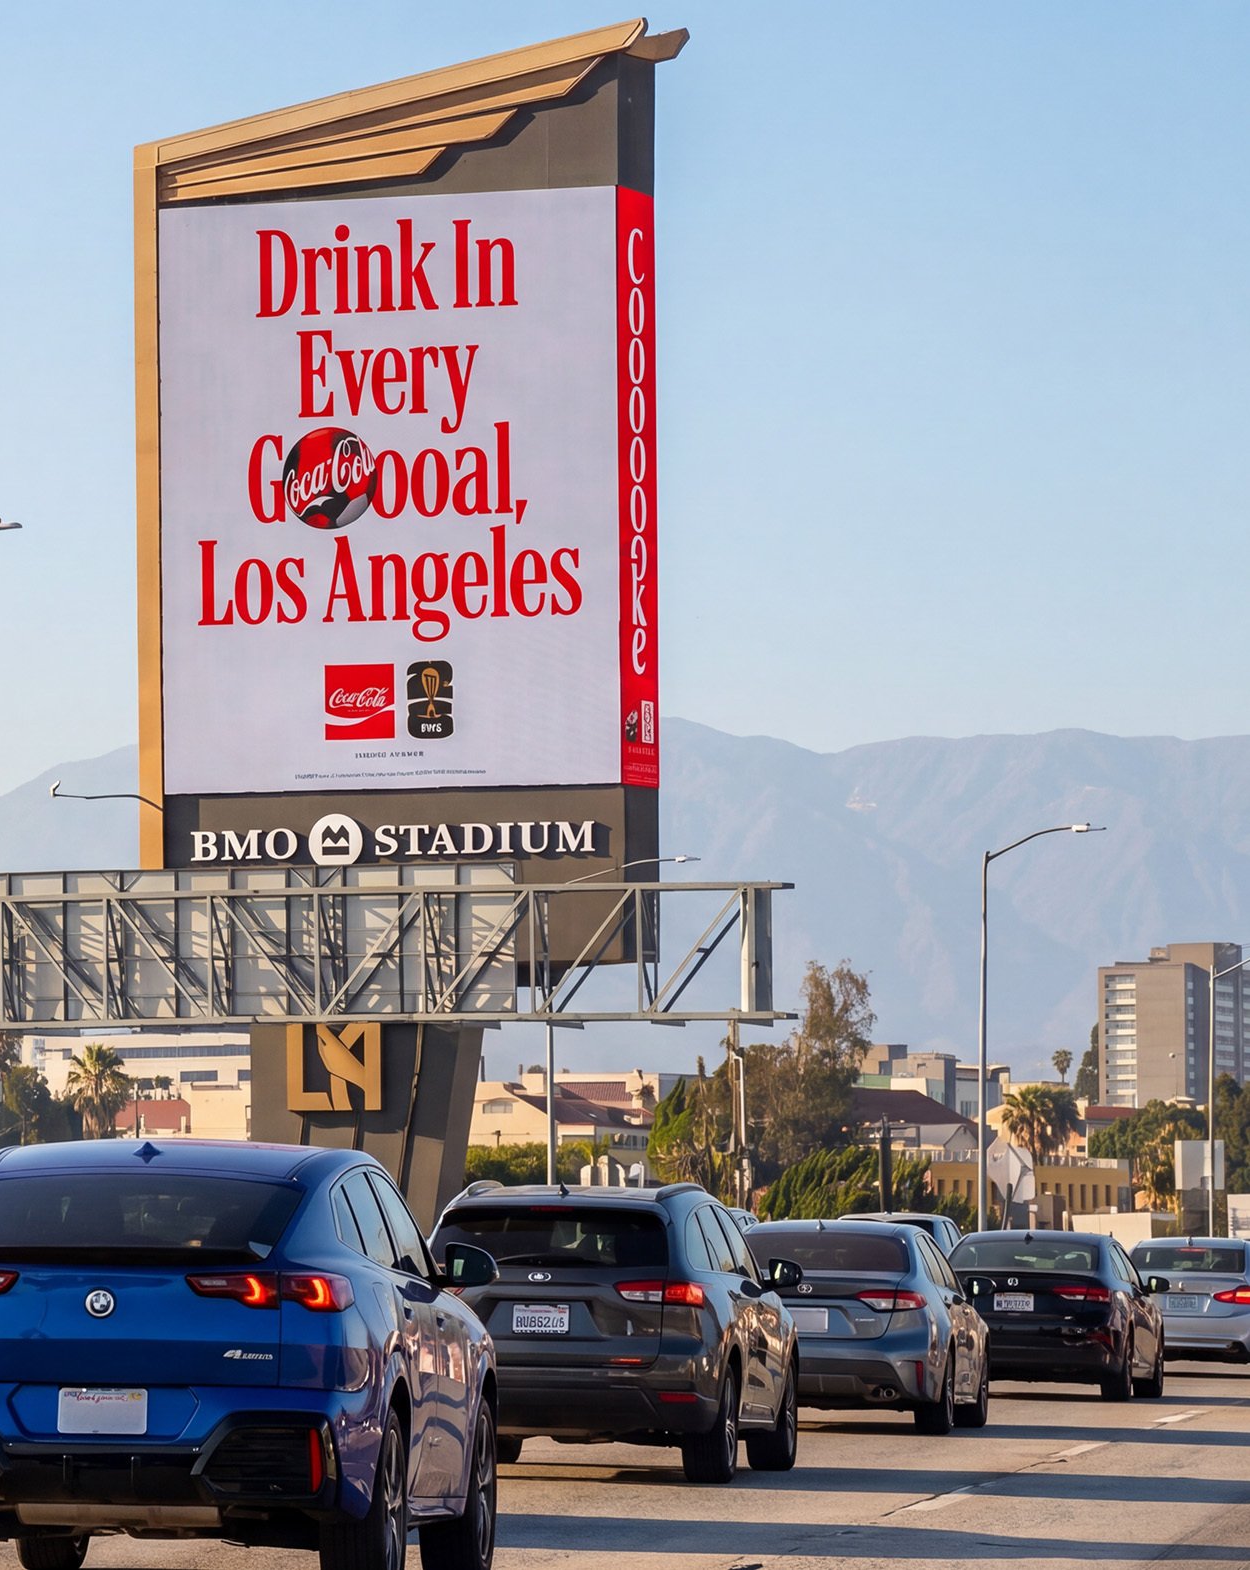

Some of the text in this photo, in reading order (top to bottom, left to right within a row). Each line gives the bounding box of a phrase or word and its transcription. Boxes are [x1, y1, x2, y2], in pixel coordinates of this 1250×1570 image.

[255, 218, 519, 318] Drink In
[296, 329, 480, 434] Every
[197, 524, 584, 644] Los Angeles
[328, 687, 390, 709] Coca-Cola
[190, 820, 596, 862] BMO STADIUM
